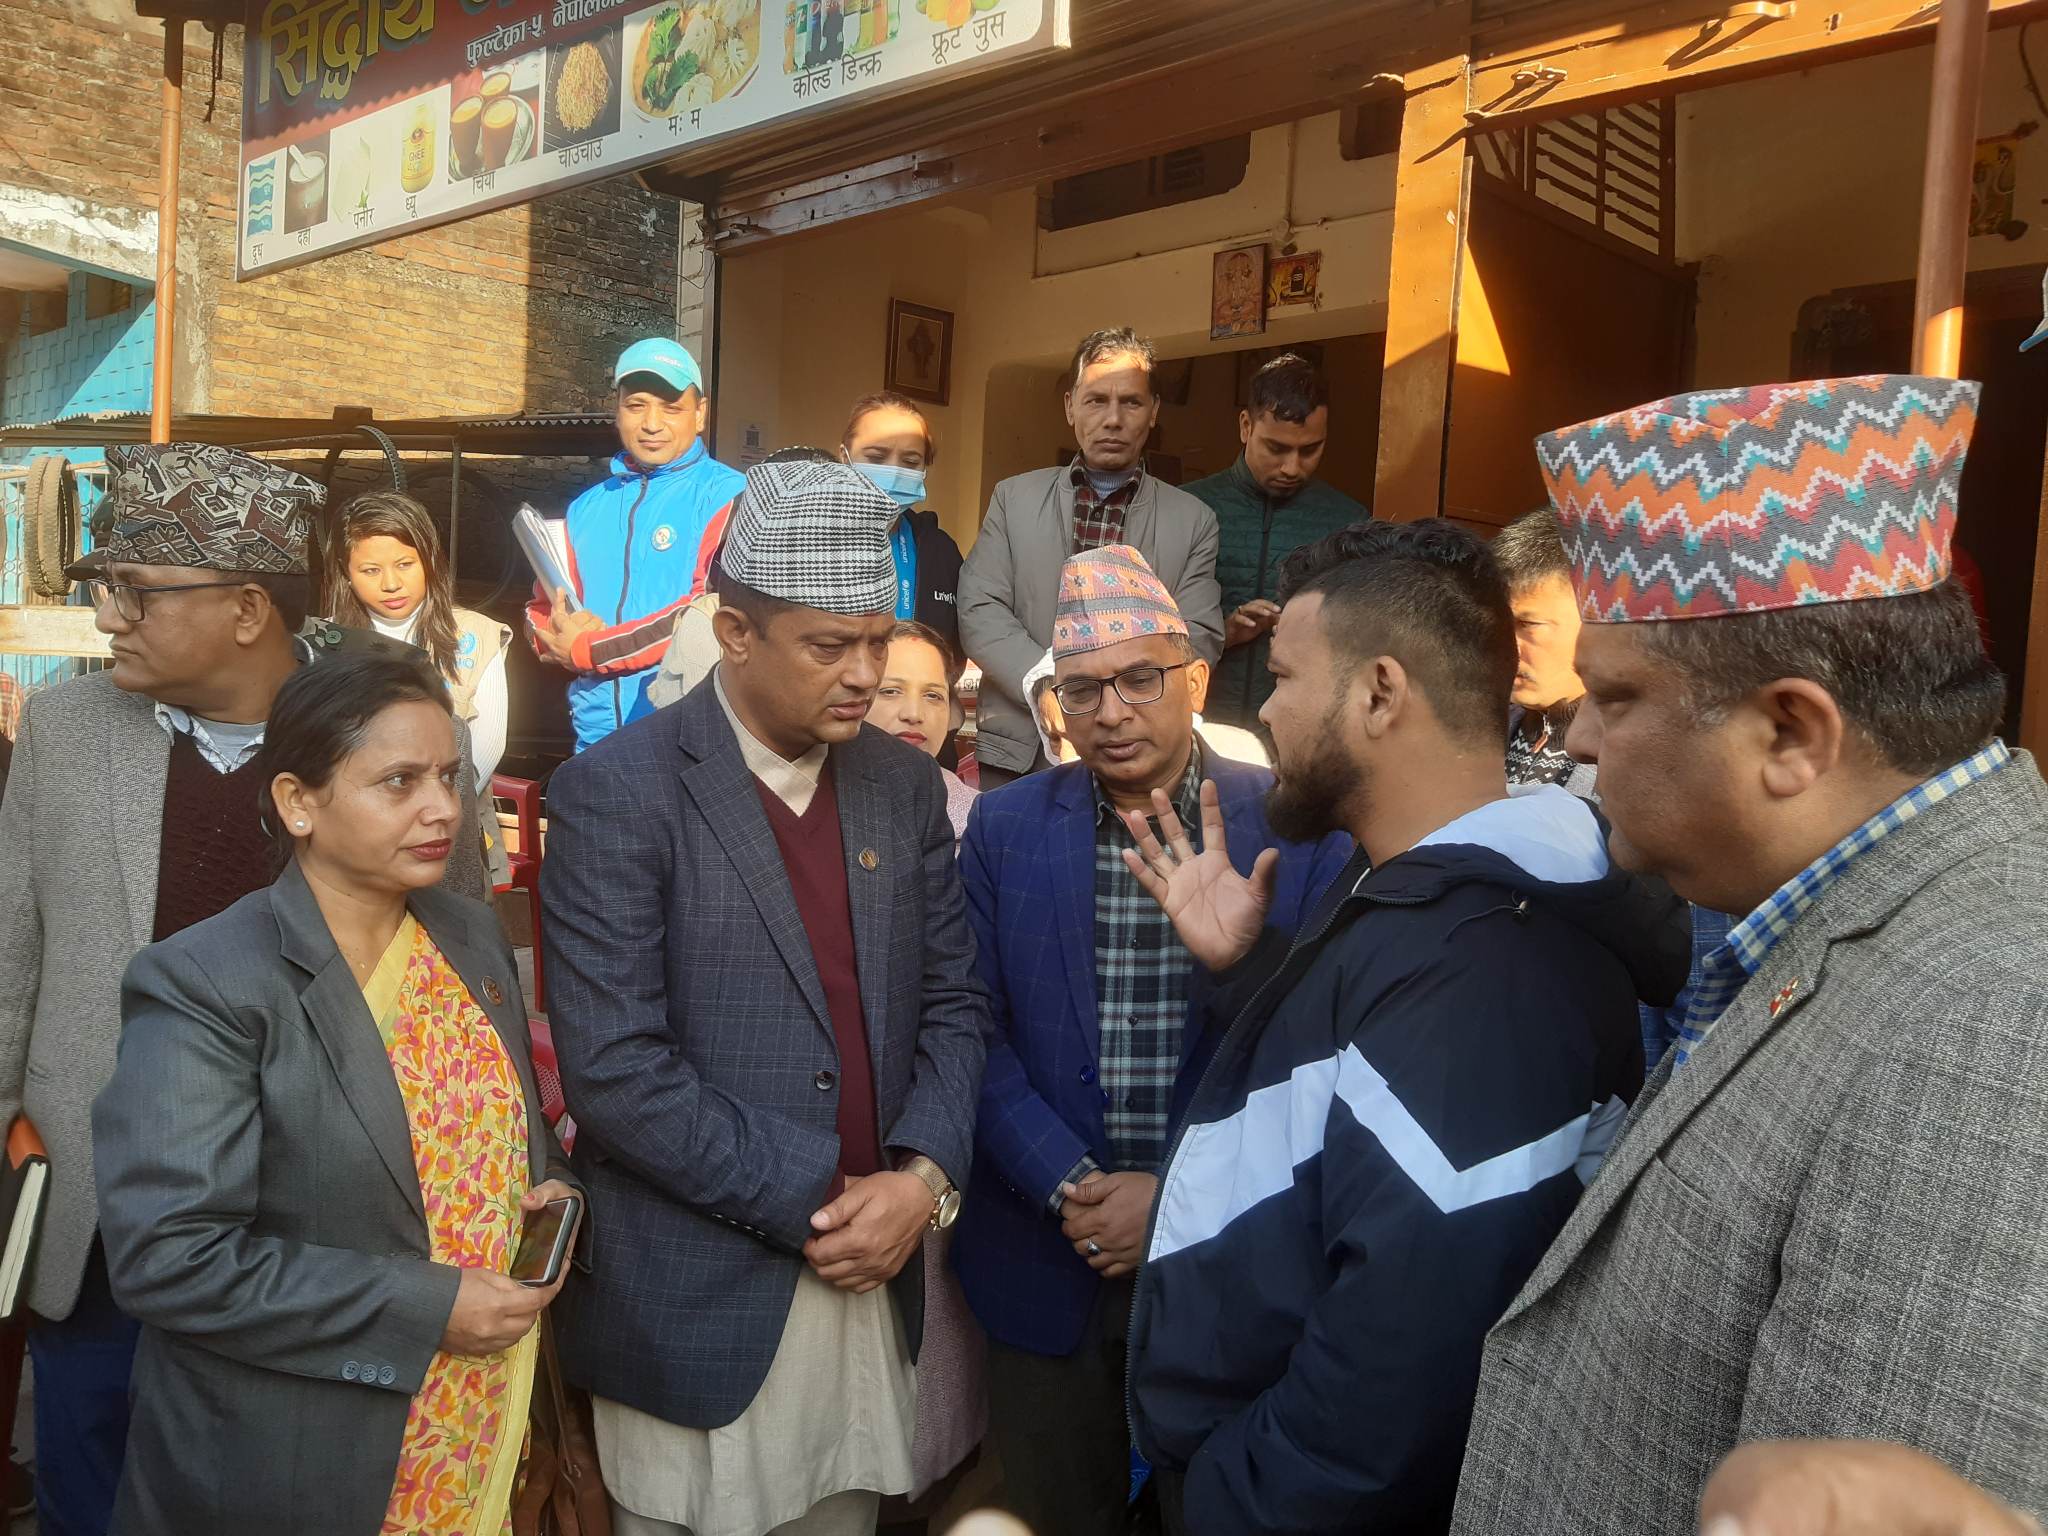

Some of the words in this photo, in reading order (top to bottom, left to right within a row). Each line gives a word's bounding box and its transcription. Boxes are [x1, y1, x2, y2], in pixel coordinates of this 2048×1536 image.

[972, 11, 1006, 51] जुस
[793, 62, 832, 99] कोल्ड
[558, 138, 604, 168] चाउचाउ
[902, 588, 910, 610] unicef
